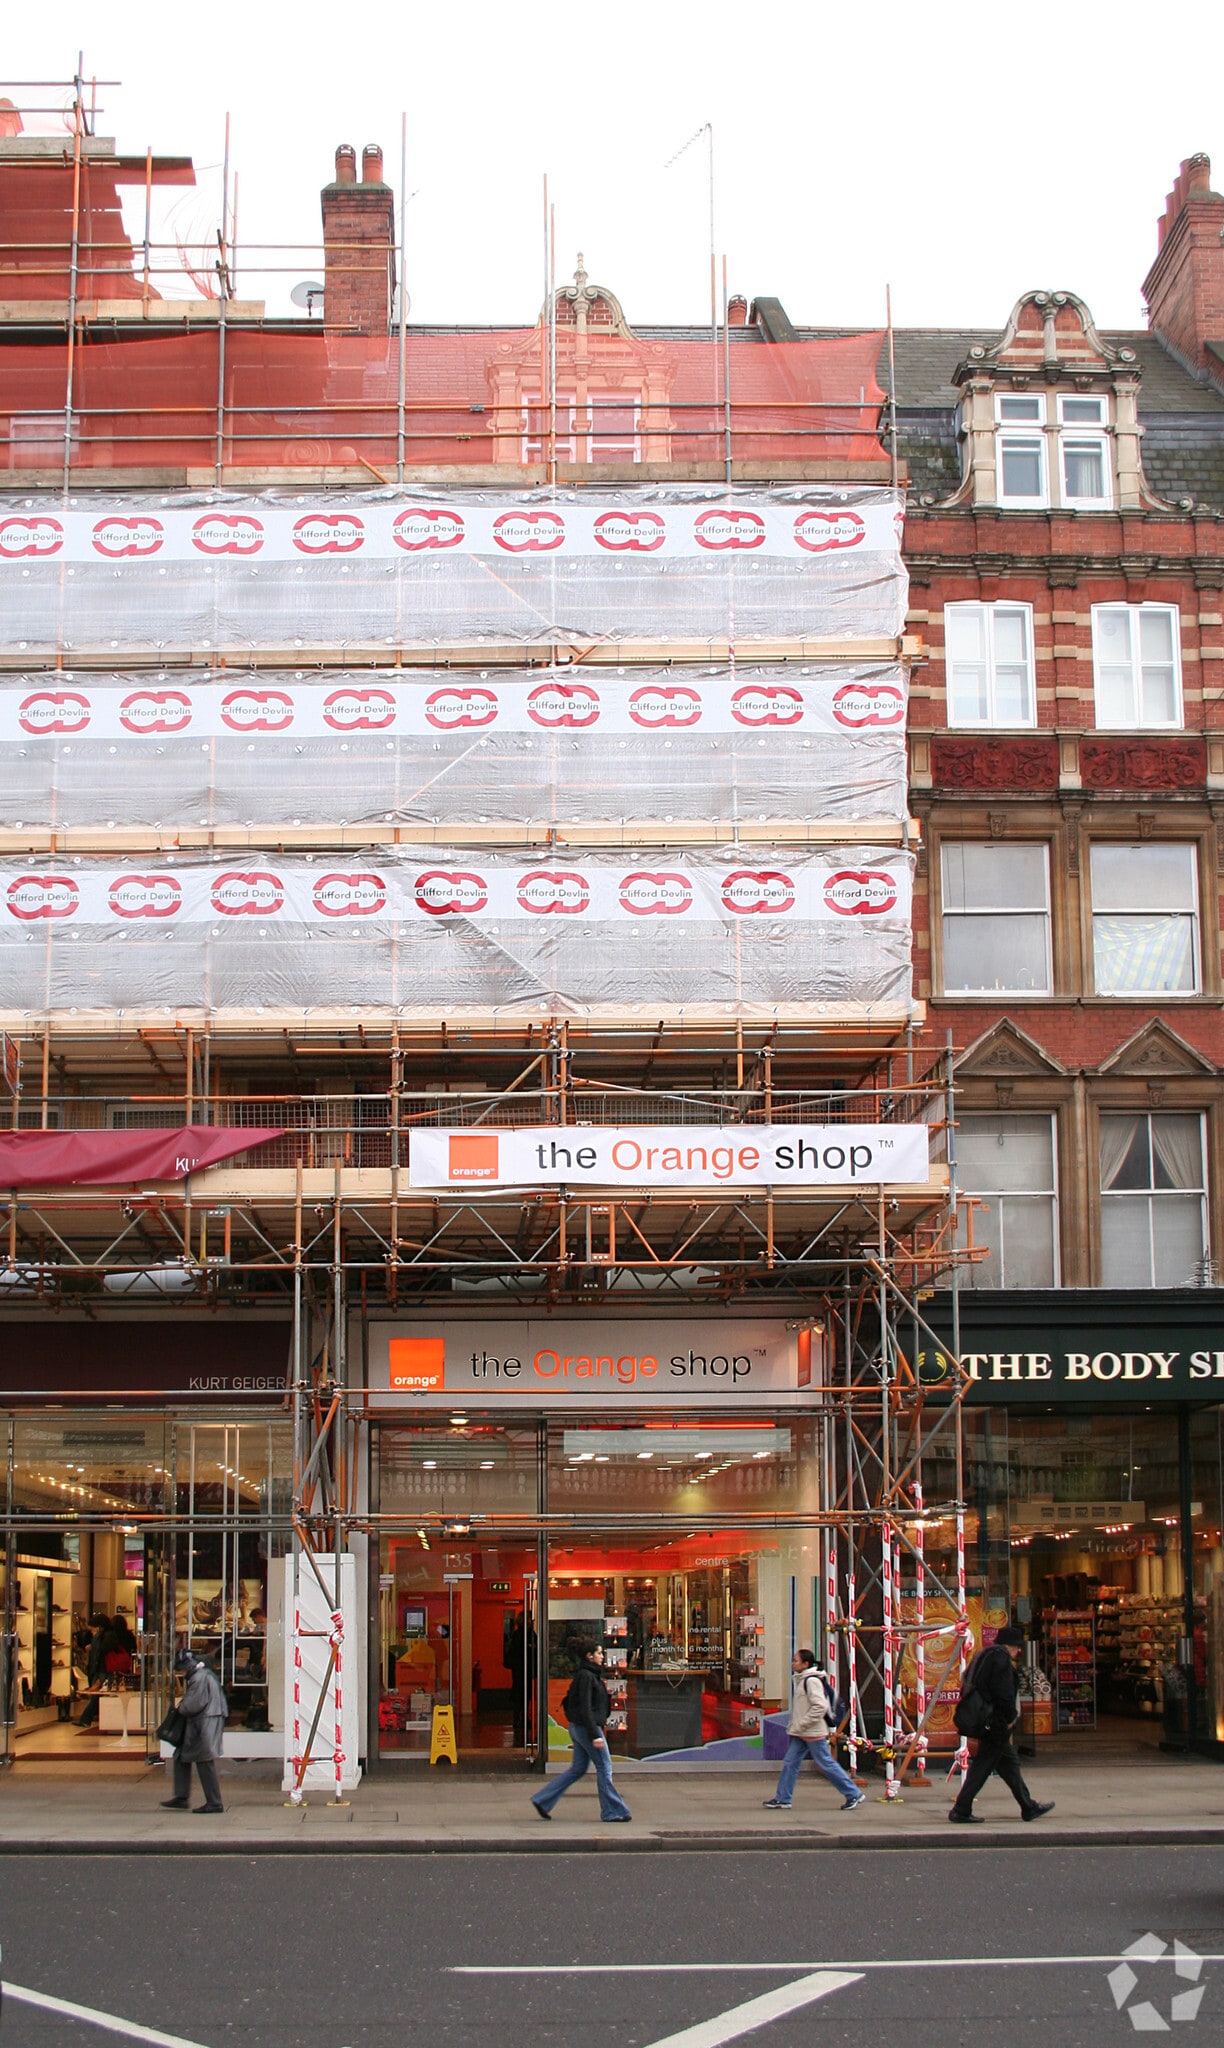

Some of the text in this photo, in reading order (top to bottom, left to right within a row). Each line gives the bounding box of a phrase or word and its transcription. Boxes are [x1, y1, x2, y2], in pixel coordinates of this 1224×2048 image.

[192, 528, 264, 540] Clifford Devlin
[293, 528, 363, 540] Clifford Devlin
[393, 524, 465, 535] Clifford Devlin
[493, 525, 565, 537] Clifford Devlin
[594, 527, 666, 537] Clifford Devlin
[694, 523, 765, 533] Clifford Devlin
[795, 526, 865, 535] Clifford Devlin
[33, 533, 63, 543] Devlin
[92, 530, 163, 542] Clifford Devlin
[221, 704, 294, 716] Clifford Devlin
[323, 703, 396, 715] Clifford Devlin
[425, 702, 496, 712] Clifford Devlin
[527, 700, 600, 712] Clifford Devlin
[629, 700, 700, 710] Clifford Devlin
[731, 700, 803, 712] Clifford Devlin
[832, 699, 903, 710] Clifford Devlin
[19, 708, 90, 718] Clifford Devlin
[120, 706, 192, 718] Clifford Devlin
[7, 891, 79, 903] Clifford Devlin
[109, 891, 182, 902] Clifford Devlin
[211, 887, 284, 900] Clifford Devlin
[312, 889, 384, 900] Clifford Devlin
[415, 887, 488, 899] Clifford Devlin
[517, 887, 589, 898] Clifford Devlin
[619, 887, 691, 898] Clifford Devlin
[721, 886, 794, 897] Clifford Devlin
[825, 887, 895, 898] Clifford Devlin
[535, 1141, 597, 1169] the
[611, 1139, 760, 1179] Orange
[774, 1139, 873, 1177] shop
[470, 1351, 522, 1378] the
[533, 1349, 659, 1384] Orange
[669, 1349, 752, 1383] shop
[959, 1353, 1053, 1381] THE
[1064, 1352, 1180, 1381] BODY
[189, 1377, 286, 1390] KURT GEIGER
[443, 1553, 472, 1568] 135
[694, 1556, 729, 1566] centre
